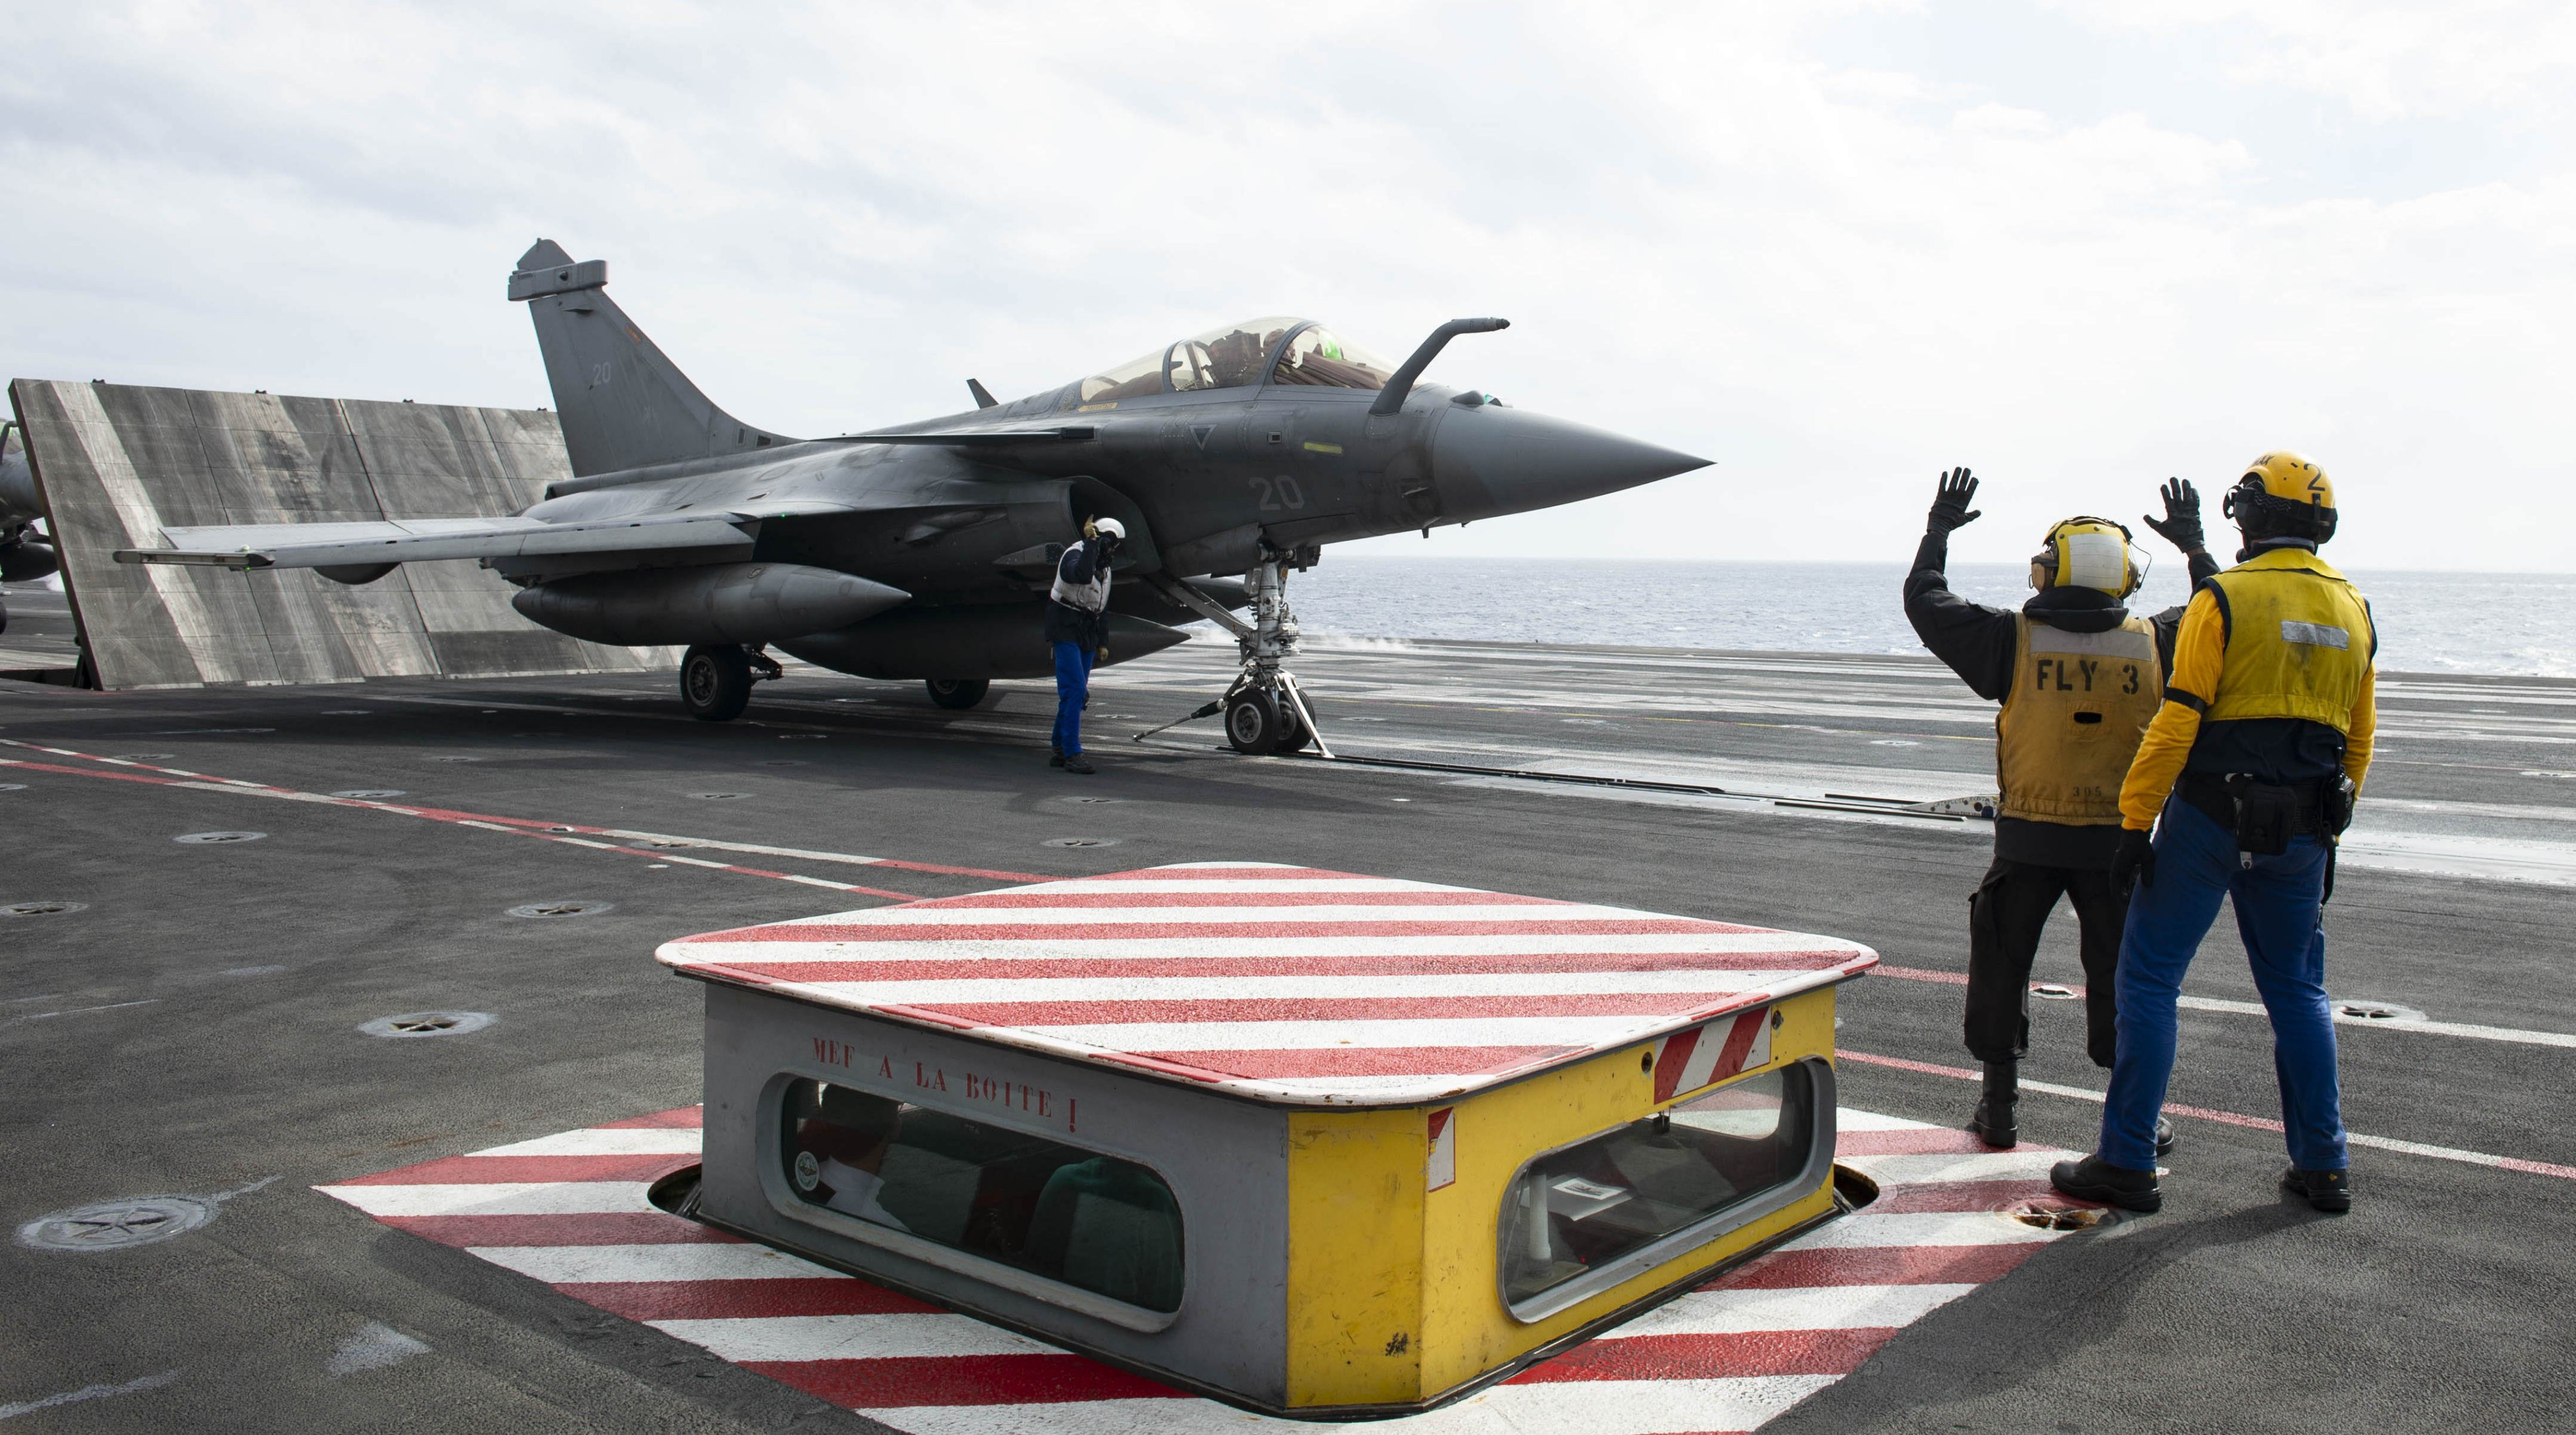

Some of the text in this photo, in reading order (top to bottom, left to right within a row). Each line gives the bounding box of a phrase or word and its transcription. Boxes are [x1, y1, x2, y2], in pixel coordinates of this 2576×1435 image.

[593, 362, 611, 385] 20
[1248, 475, 1304, 511] 20
[2303, 463, 2326, 492] 2
[2037, 659, 2139, 695] FLY 3
[812, 1036, 855, 1068] MEF
[878, 1054, 894, 1080] A
[916, 1061, 947, 1092] LA
[965, 1072, 1053, 1118] BOITE
